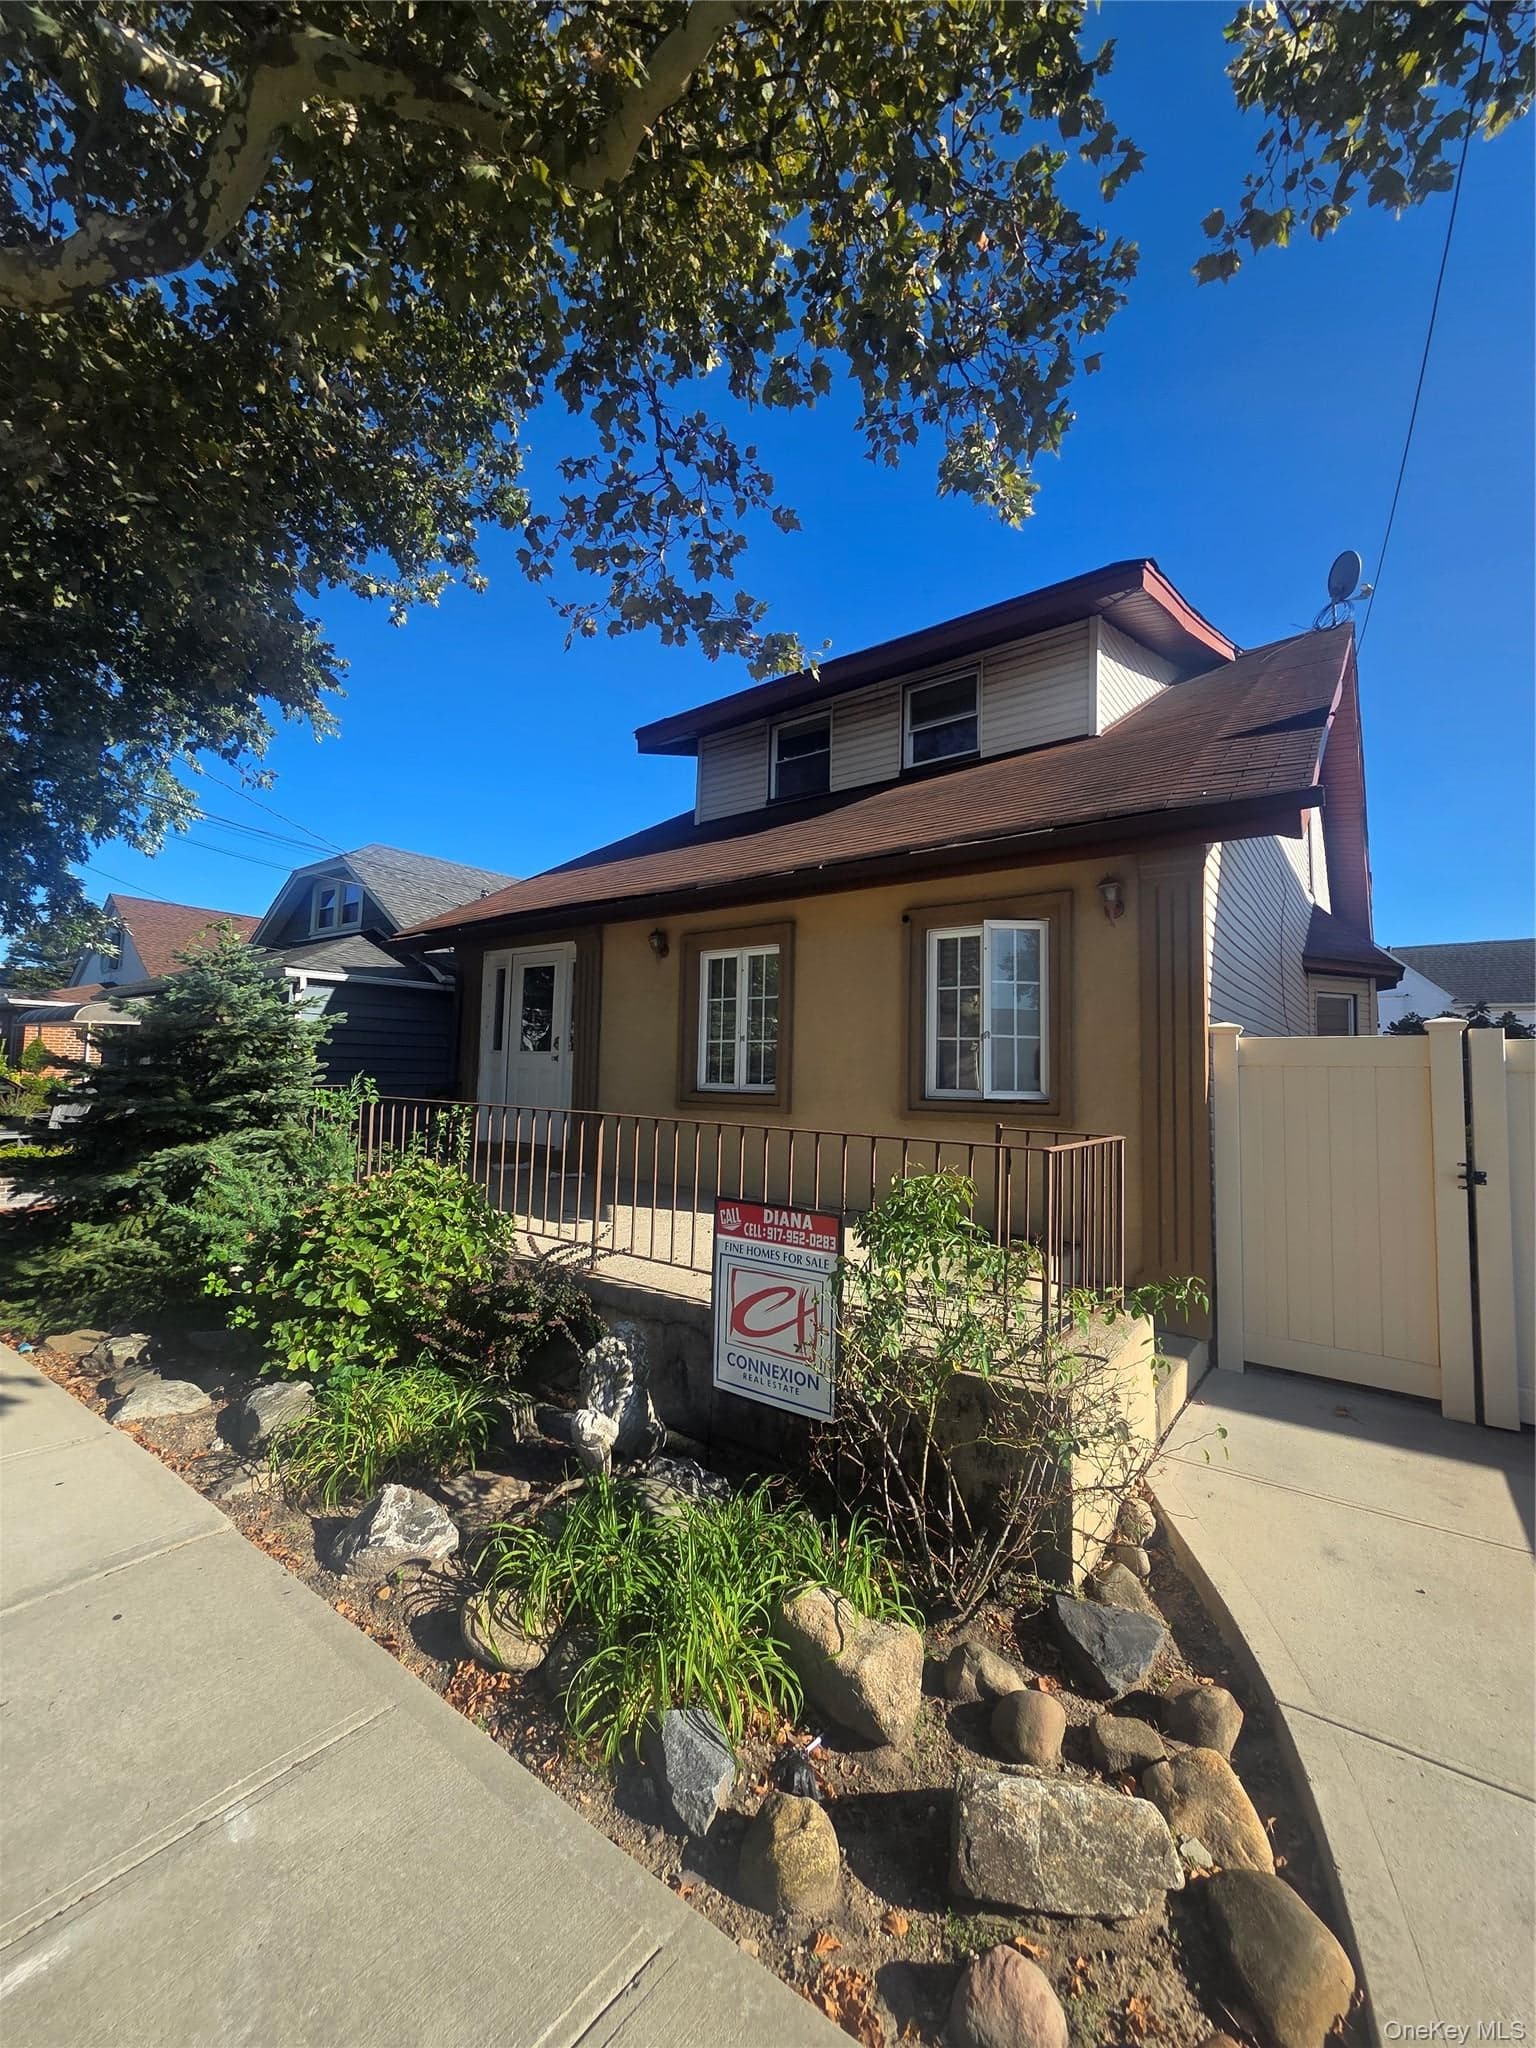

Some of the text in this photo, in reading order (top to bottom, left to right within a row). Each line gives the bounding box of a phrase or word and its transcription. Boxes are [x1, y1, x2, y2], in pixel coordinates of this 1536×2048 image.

[719, 1207, 741, 1225] CALL
[763, 1209, 813, 1231] DIANA
[724, 1241, 830, 1270] FINE HOMES FOR SALE
[727, 1352, 819, 1391] CONNEXION
[742, 1372, 801, 1396] REAL ESTATE
